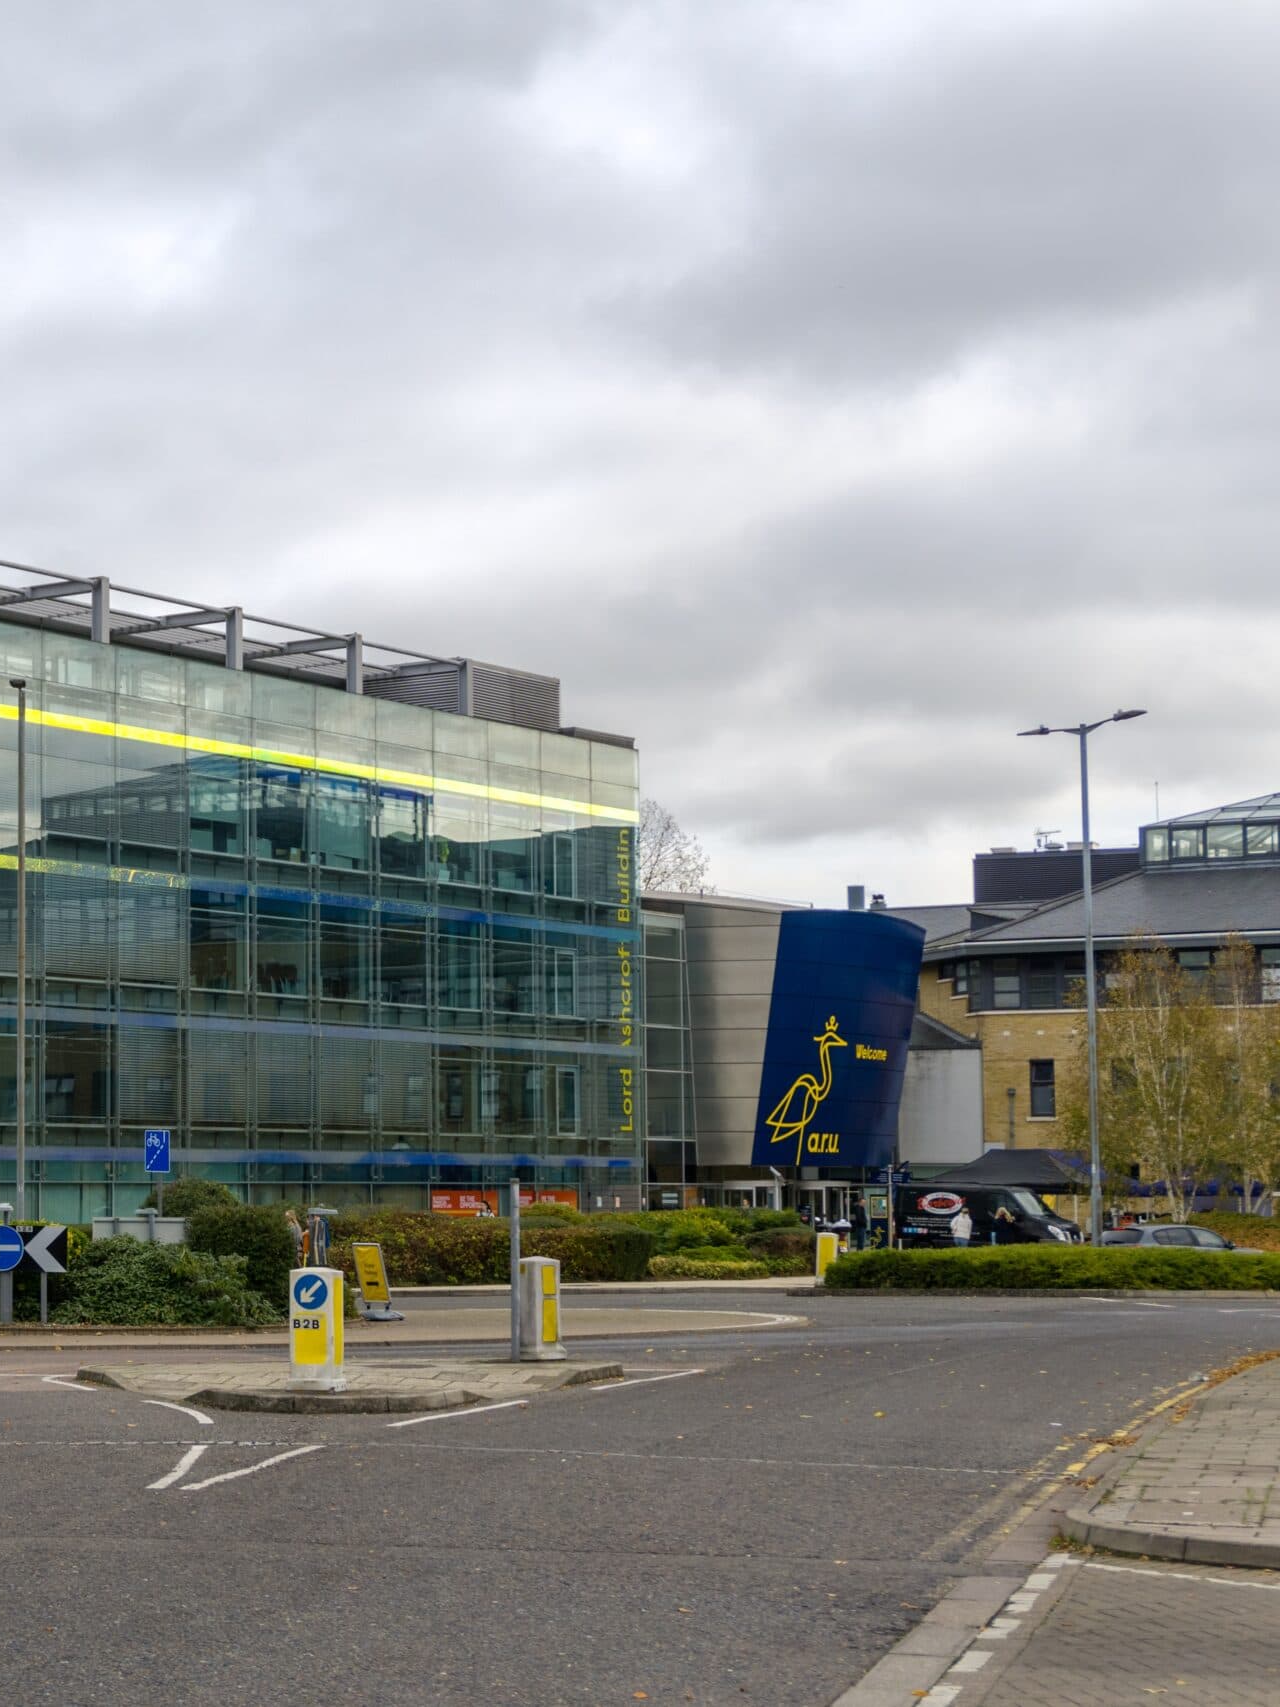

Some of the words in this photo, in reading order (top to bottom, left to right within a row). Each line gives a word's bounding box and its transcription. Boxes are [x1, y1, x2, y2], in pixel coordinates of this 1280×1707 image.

[617, 829, 630, 922] Buildin
[618, 941, 632, 1047] shcrof
[856, 1044, 887, 1061] Welcome
[621, 1069, 633, 1132] Lord
